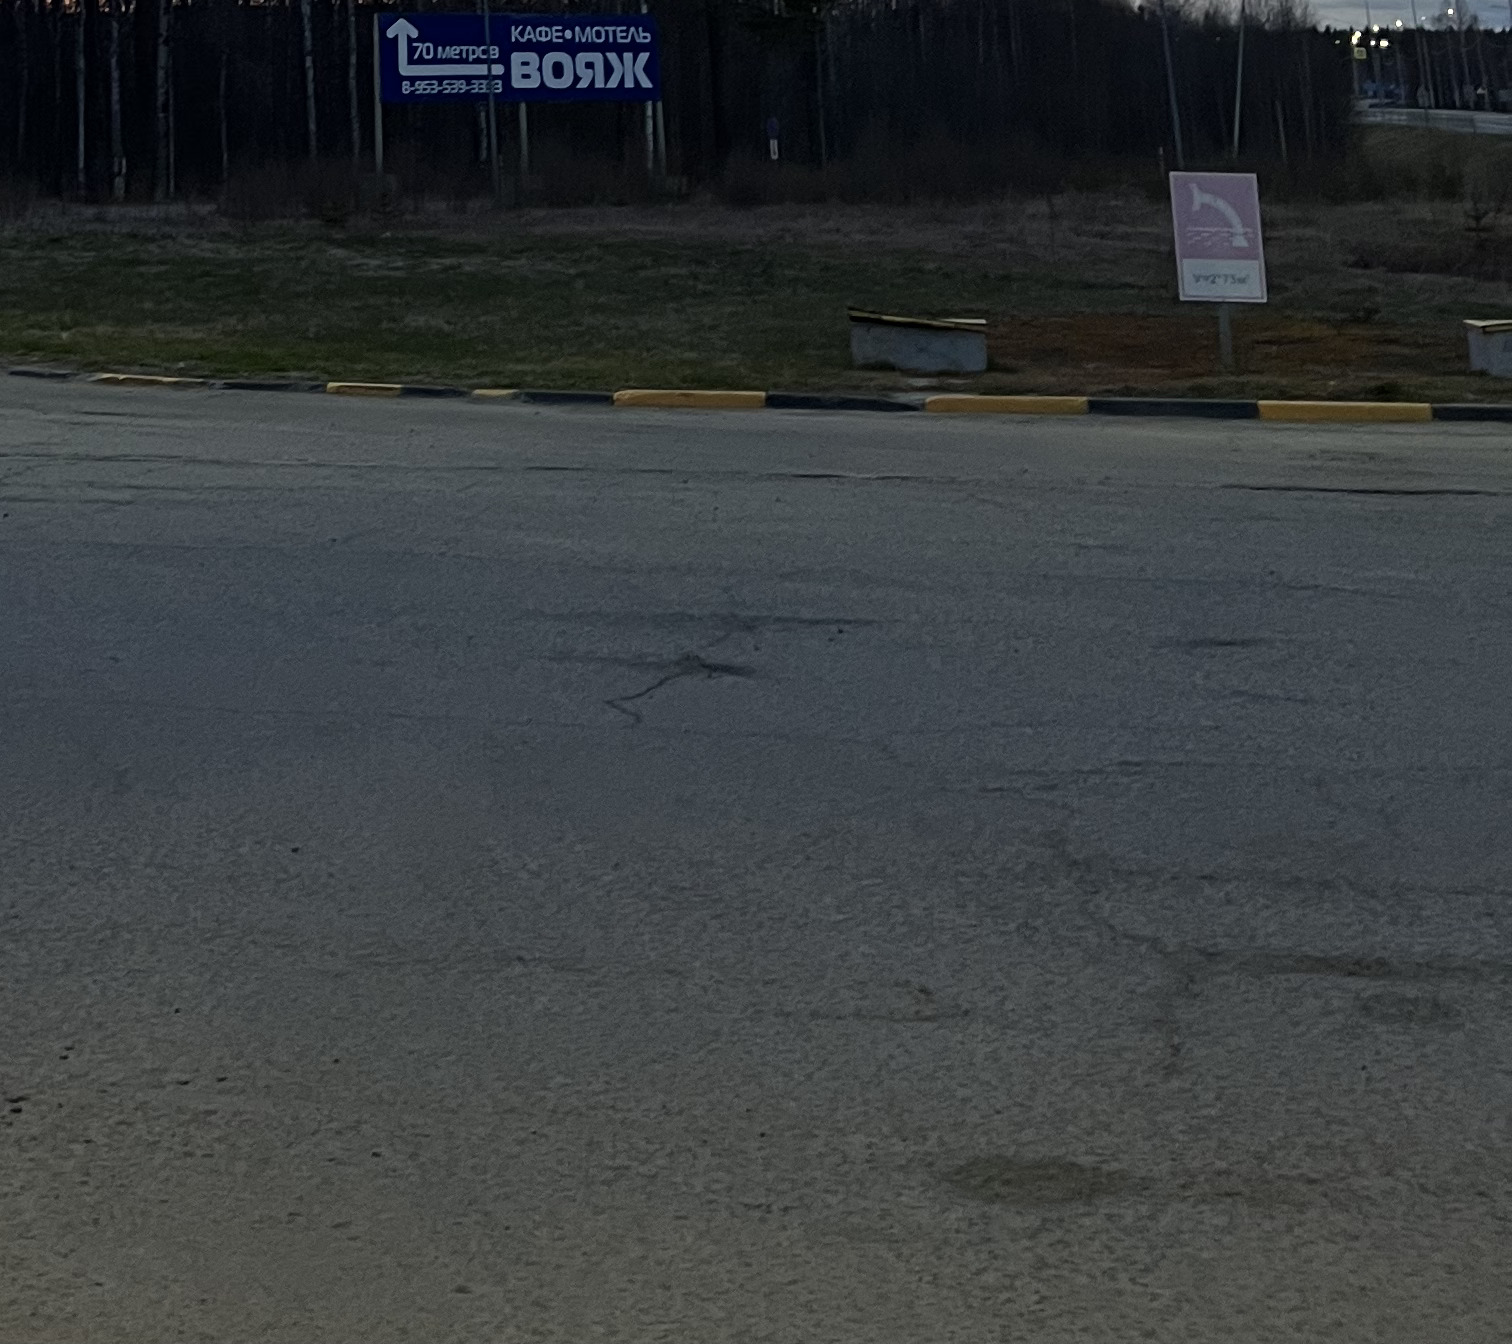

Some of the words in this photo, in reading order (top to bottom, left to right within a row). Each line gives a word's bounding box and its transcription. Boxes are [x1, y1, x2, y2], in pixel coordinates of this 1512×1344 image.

[412, 42, 434, 60] 70
[437, 44, 500, 62] метров
[510, 51, 654, 89] ВОЯЖ
